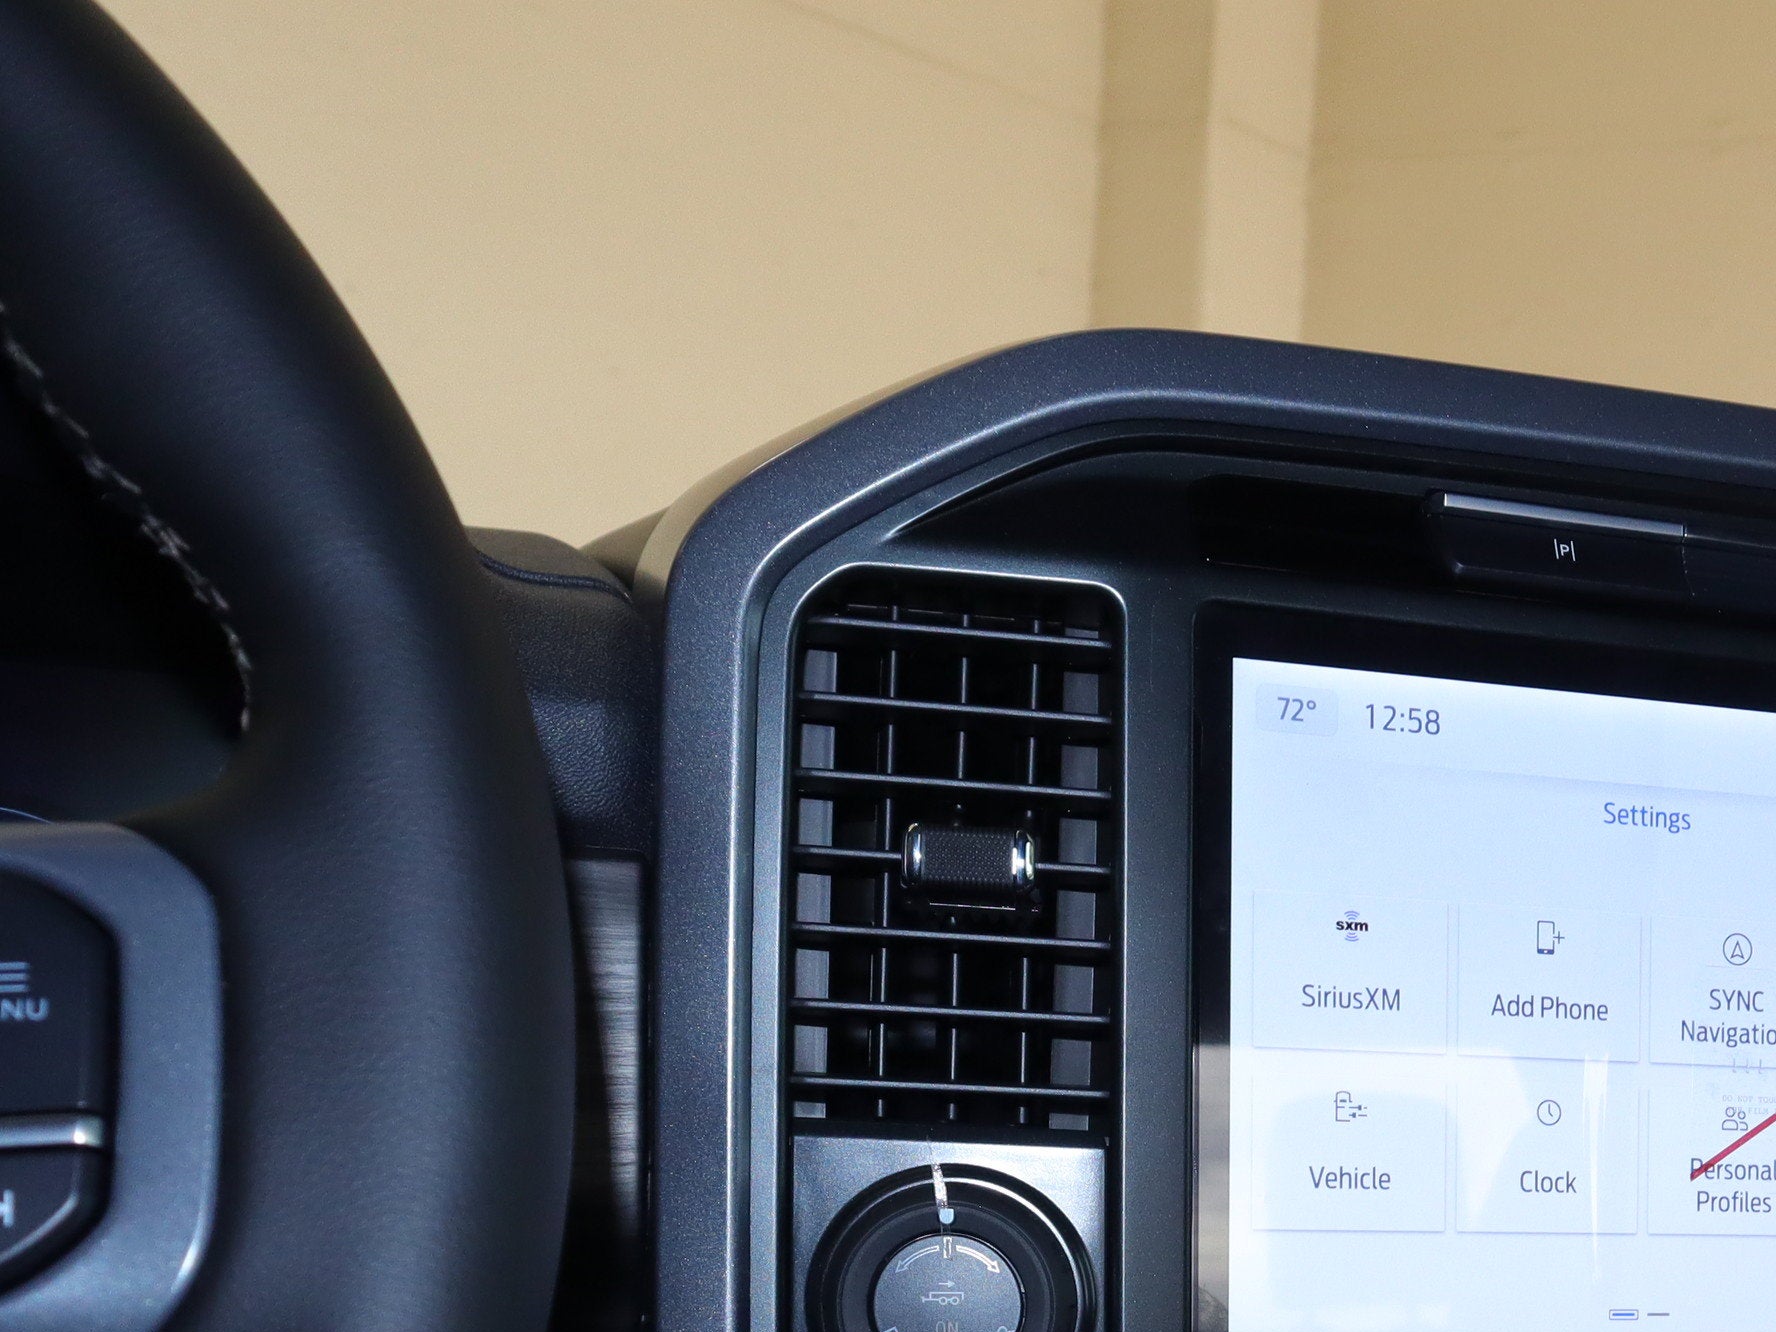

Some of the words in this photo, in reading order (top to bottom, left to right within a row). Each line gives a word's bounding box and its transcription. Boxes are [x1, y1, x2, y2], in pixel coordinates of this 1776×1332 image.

[1277, 697, 1317, 723] 72°
[1366, 704, 1441, 735] 12:58
[1603, 802, 1692, 833] Settings
[1336, 920, 1369, 932] sxm
[1301, 984, 1401, 1012] SiriusXM
[1491, 995, 1535, 1018] Add
[1541, 997, 1610, 1021] Phone
[1709, 989, 1764, 1014] SYNC
[1309, 1166, 1391, 1191] Vehicle
[1519, 1170, 1577, 1194] Clock
[1697, 1191, 1772, 1214] Profiles
